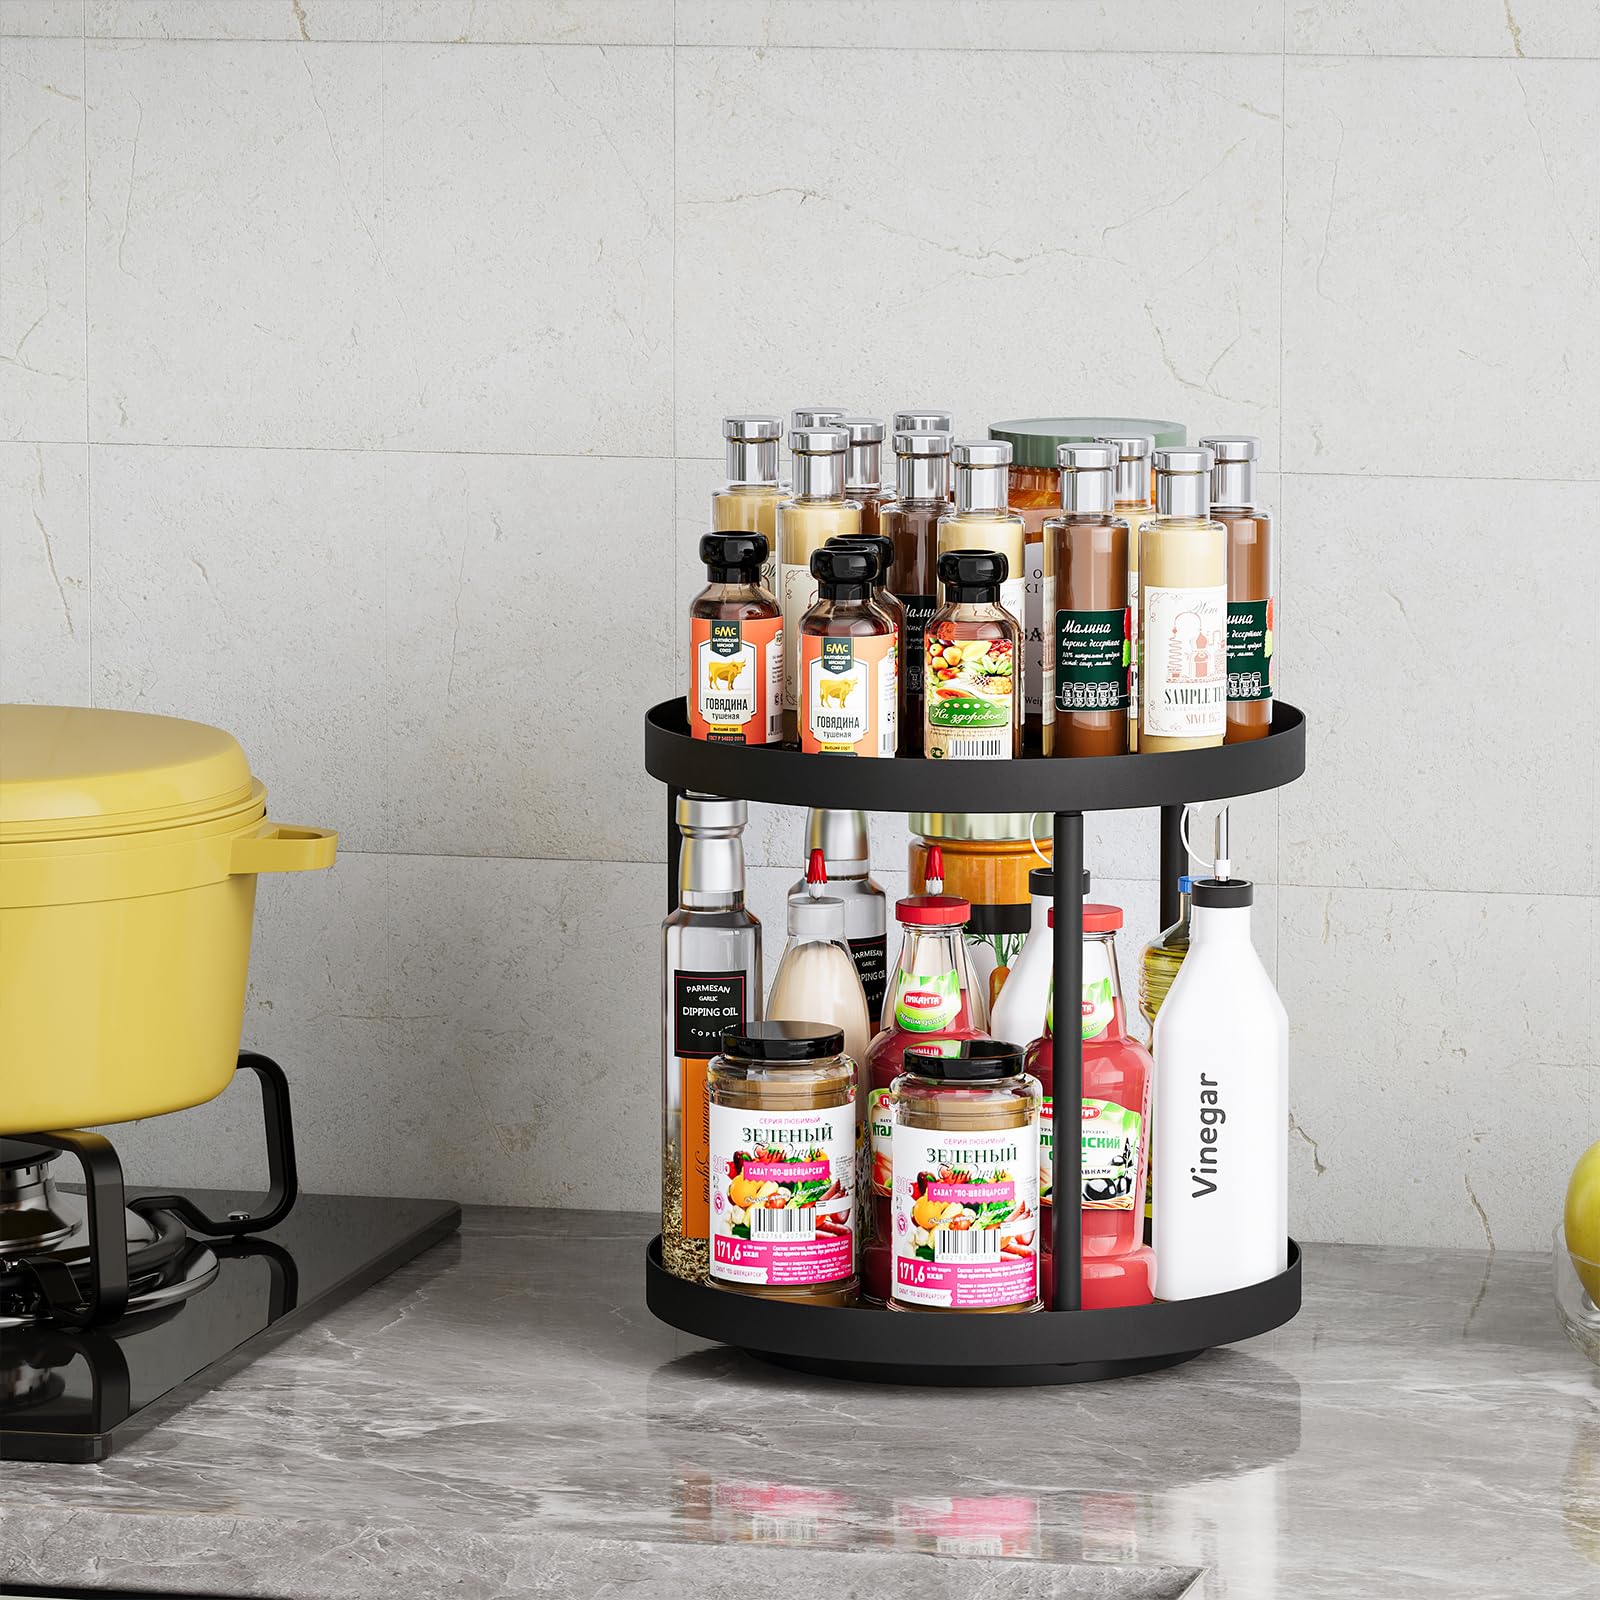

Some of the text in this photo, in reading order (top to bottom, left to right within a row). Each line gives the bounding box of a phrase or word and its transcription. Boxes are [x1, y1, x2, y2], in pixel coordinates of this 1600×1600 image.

[1062, 620, 1112, 634] Малина
[1164, 688, 1211, 705] SAMPLE
[706, 697, 748, 711] ГОВЯДИНА
[712, 712, 740, 720] тушеная
[817, 715, 860, 730] ГОВЯДИНА
[823, 731, 852, 739] тушеная
[686, 984, 731, 994] PARMESAN
[682, 1006, 739, 1017] DIPPING OIL
[759, 1117, 783, 1125] СЕРИЯ
[742, 1122, 833, 1143] ЗЕЛЕНЫЙ
[1190, 1072, 1226, 1198] Vinegar
[926, 1143, 1017, 1164] ЗЕЛЕНЫЙ
[748, 1166, 826, 1177] САЛАТ "ПО-ШВЕЙЦАРСКИ"
[932, 1187, 1011, 1198] САЛАТ "ПО-ШВЕЙЦАРСКИ"
[716, 1240, 742, 1262] 171,6
[899, 1261, 925, 1284] 171,6
